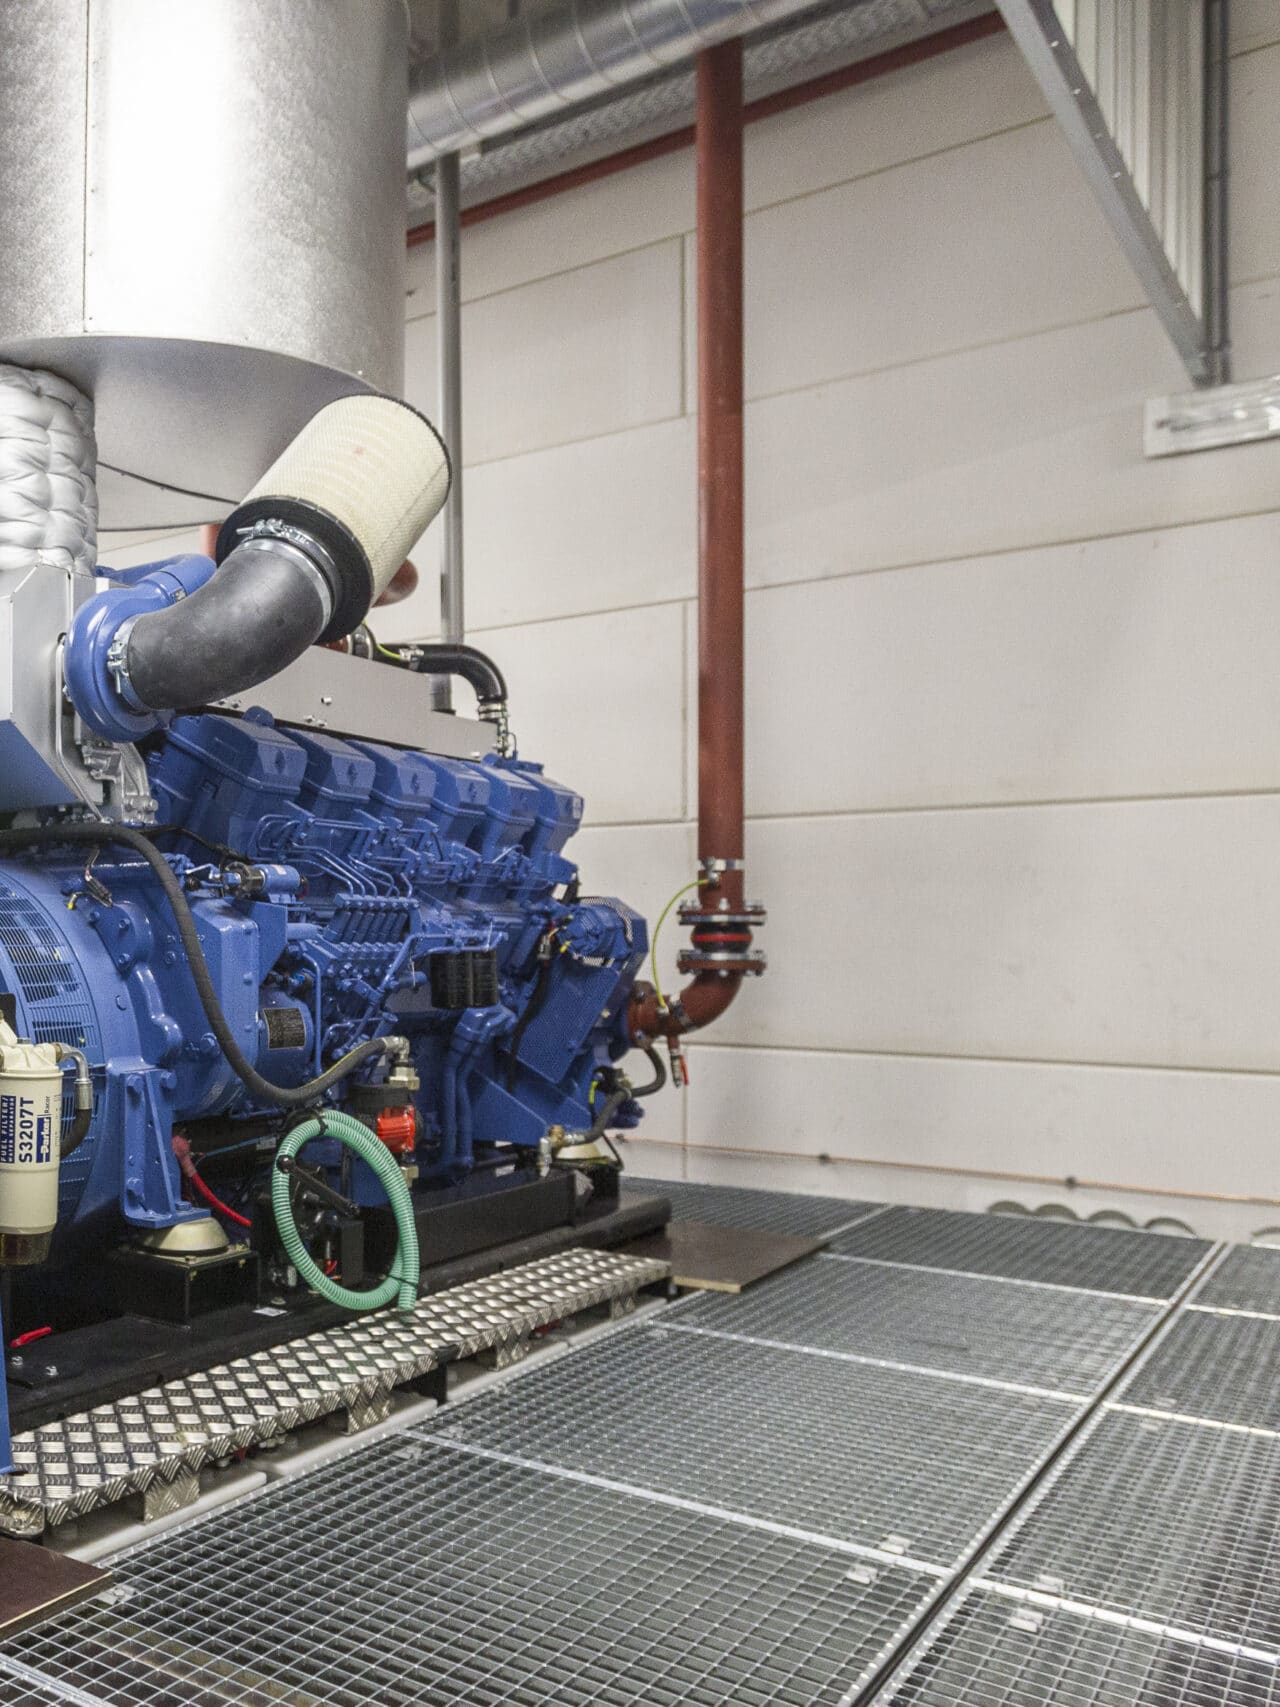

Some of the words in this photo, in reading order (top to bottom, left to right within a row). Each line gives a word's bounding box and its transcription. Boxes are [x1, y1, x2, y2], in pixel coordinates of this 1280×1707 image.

[1, 1135, 9, 1162] FUEL
[18, 1096, 34, 1163] S3207T
[40, 1117, 50, 1156] Parker
